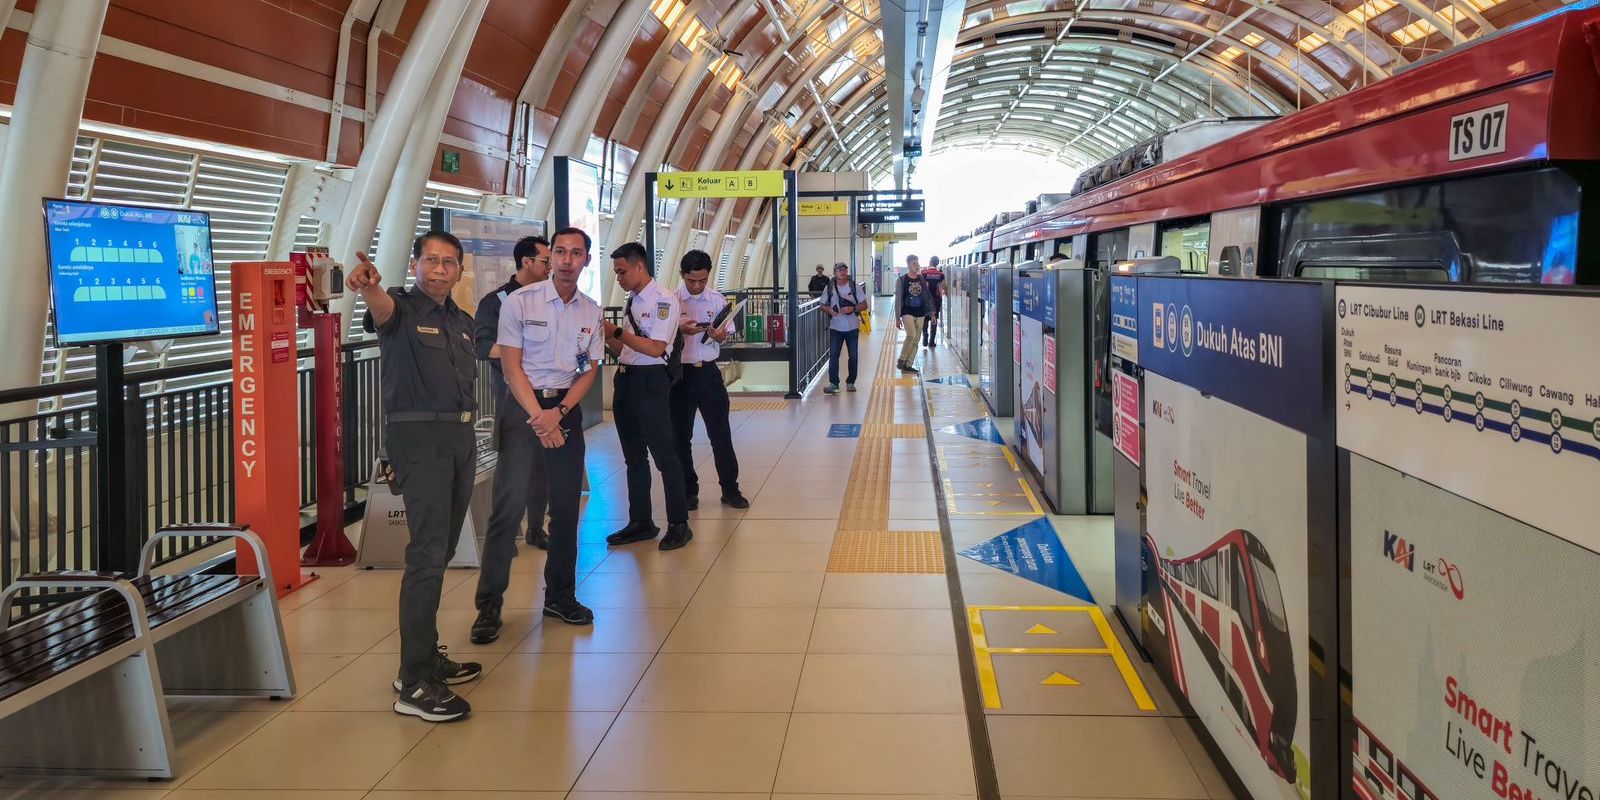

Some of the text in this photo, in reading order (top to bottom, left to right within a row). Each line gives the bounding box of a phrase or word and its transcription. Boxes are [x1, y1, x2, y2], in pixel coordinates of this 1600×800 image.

[1453, 110, 1504, 154] TS 07
[698, 178, 721, 186] Keluar
[1350, 304, 1408, 321] LRT Cibubur Line
[1431, 310, 1504, 331] LRT Bekasi Line
[1341, 327, 1354, 336] Dukuh
[1197, 321, 1283, 368] Dukuh Atas BNI
[1384, 344, 1402, 356] Rasuna
[1359, 351, 1380, 363] Setiabudi
[1388, 357, 1398, 367] Said
[1434, 353, 1461, 367] Pancoran
[1407, 360, 1431, 375] Kuningan
[1435, 366, 1461, 382] bank bjb
[239, 292, 256, 478] EMERGENCY
[1468, 371, 1491, 386] Cikoko
[1500, 377, 1532, 397] Ciliwung
[1540, 385, 1574, 405] Cawang
[1174, 460, 1210, 500] Smart Travel
[1174, 483, 1206, 520] Live Better
[1384, 529, 1415, 572] KAI
[1423, 561, 1435, 573] LRT
[1444, 676, 1513, 754] Smart
[1446, 721, 1485, 779] Live
